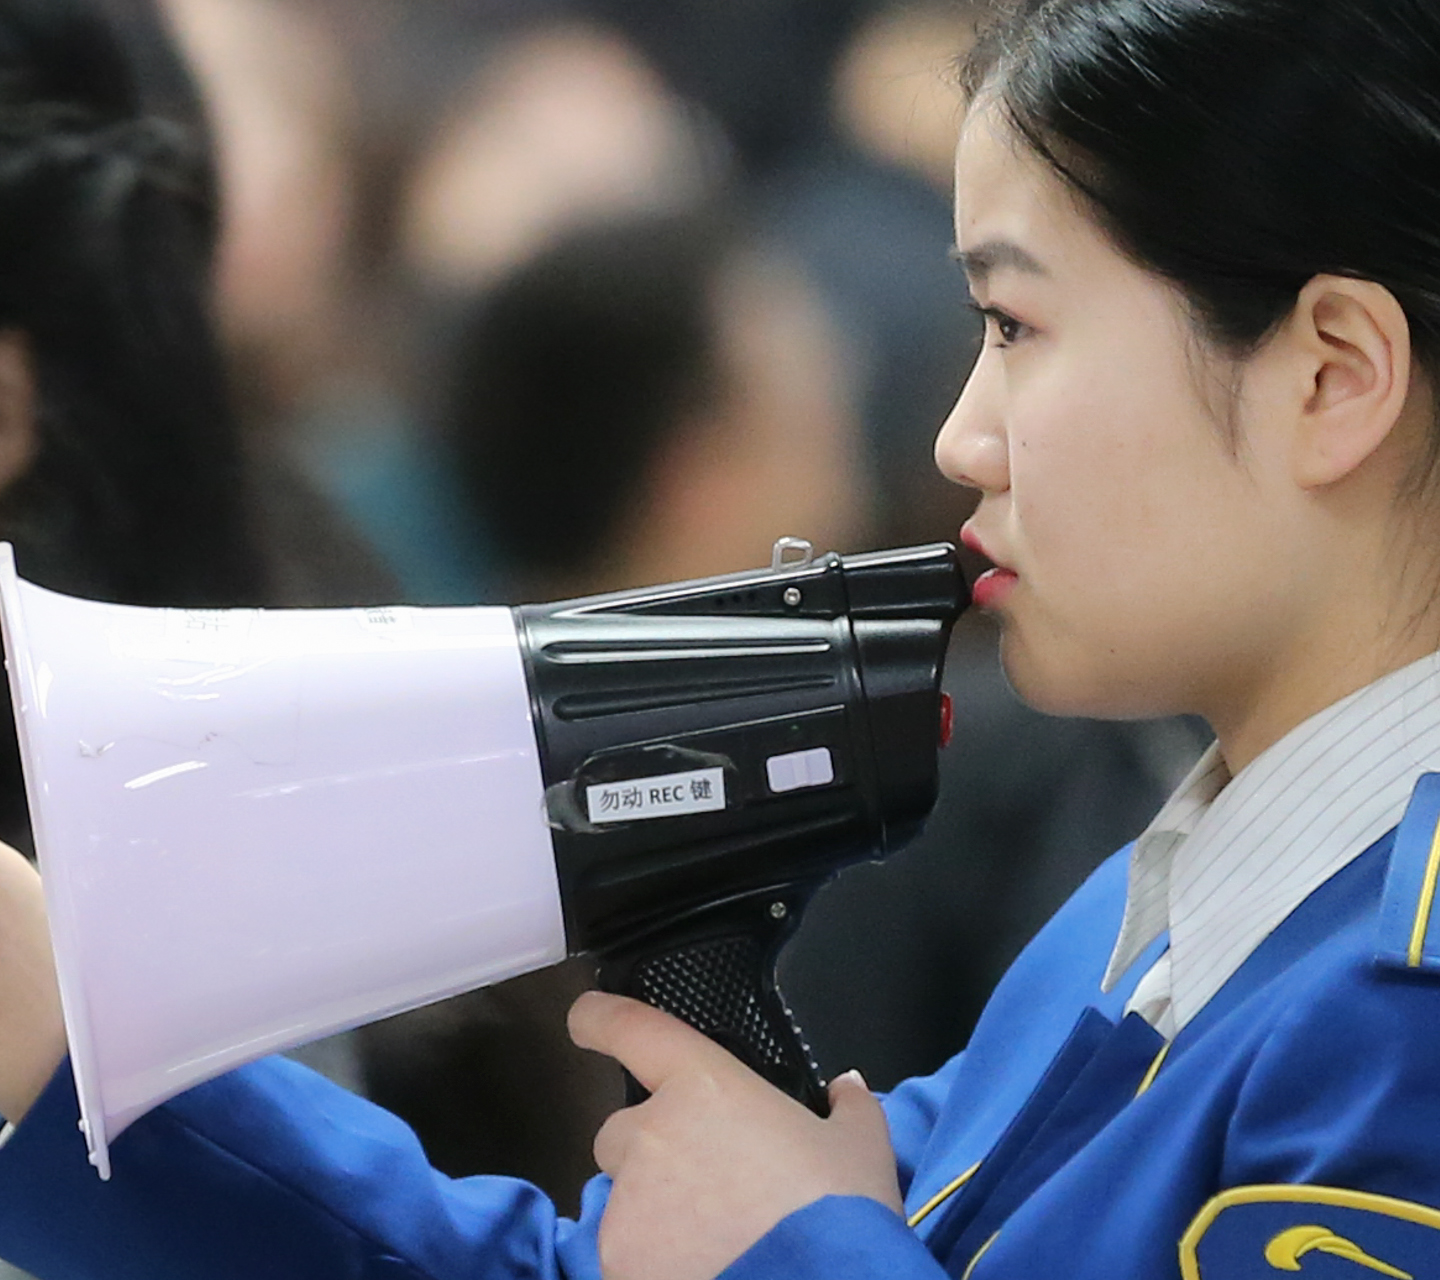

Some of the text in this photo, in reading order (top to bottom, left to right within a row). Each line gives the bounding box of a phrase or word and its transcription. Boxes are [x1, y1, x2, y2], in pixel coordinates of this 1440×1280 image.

[599, 778, 713, 812] 勿动 REC 键
